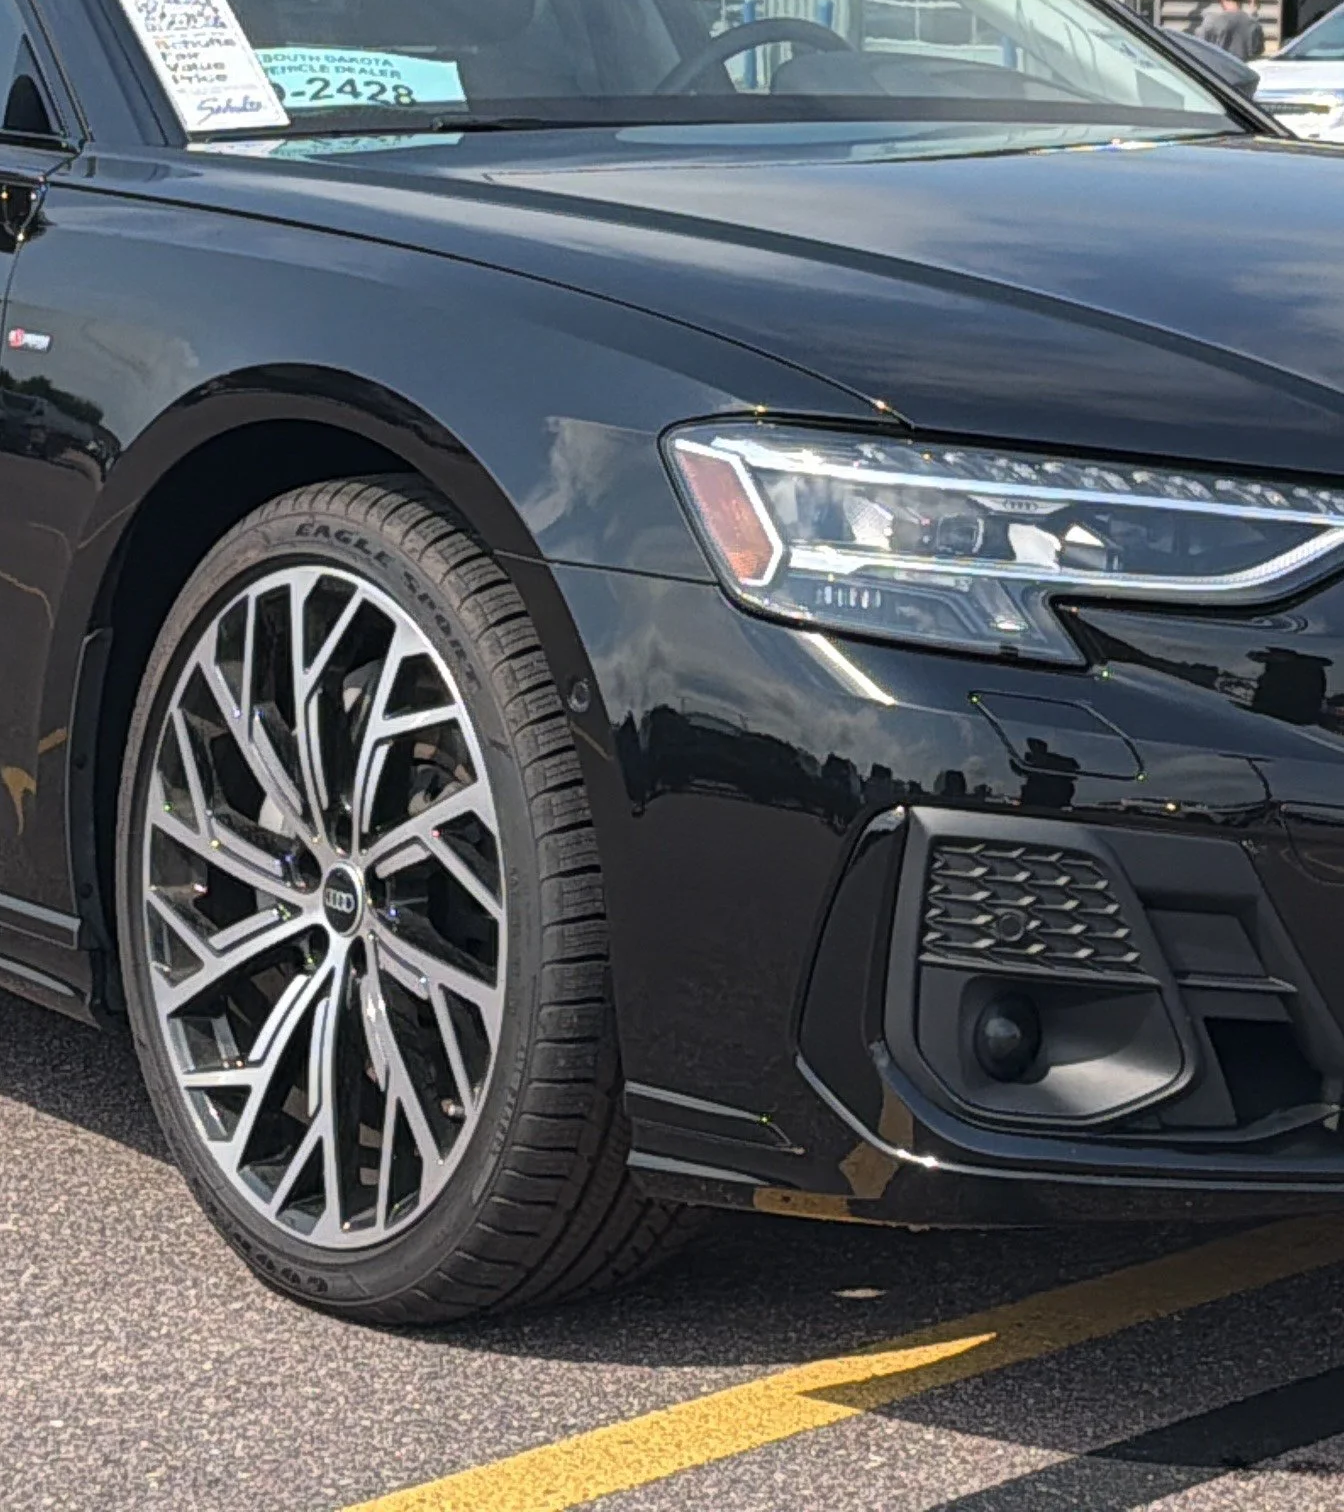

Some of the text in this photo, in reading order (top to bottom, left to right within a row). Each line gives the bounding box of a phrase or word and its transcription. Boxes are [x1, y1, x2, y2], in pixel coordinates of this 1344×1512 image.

[323, 54, 394, 68] DAKOTA
[334, 66, 402, 80] DEALER
[295, 522, 396, 569] EAGLE
